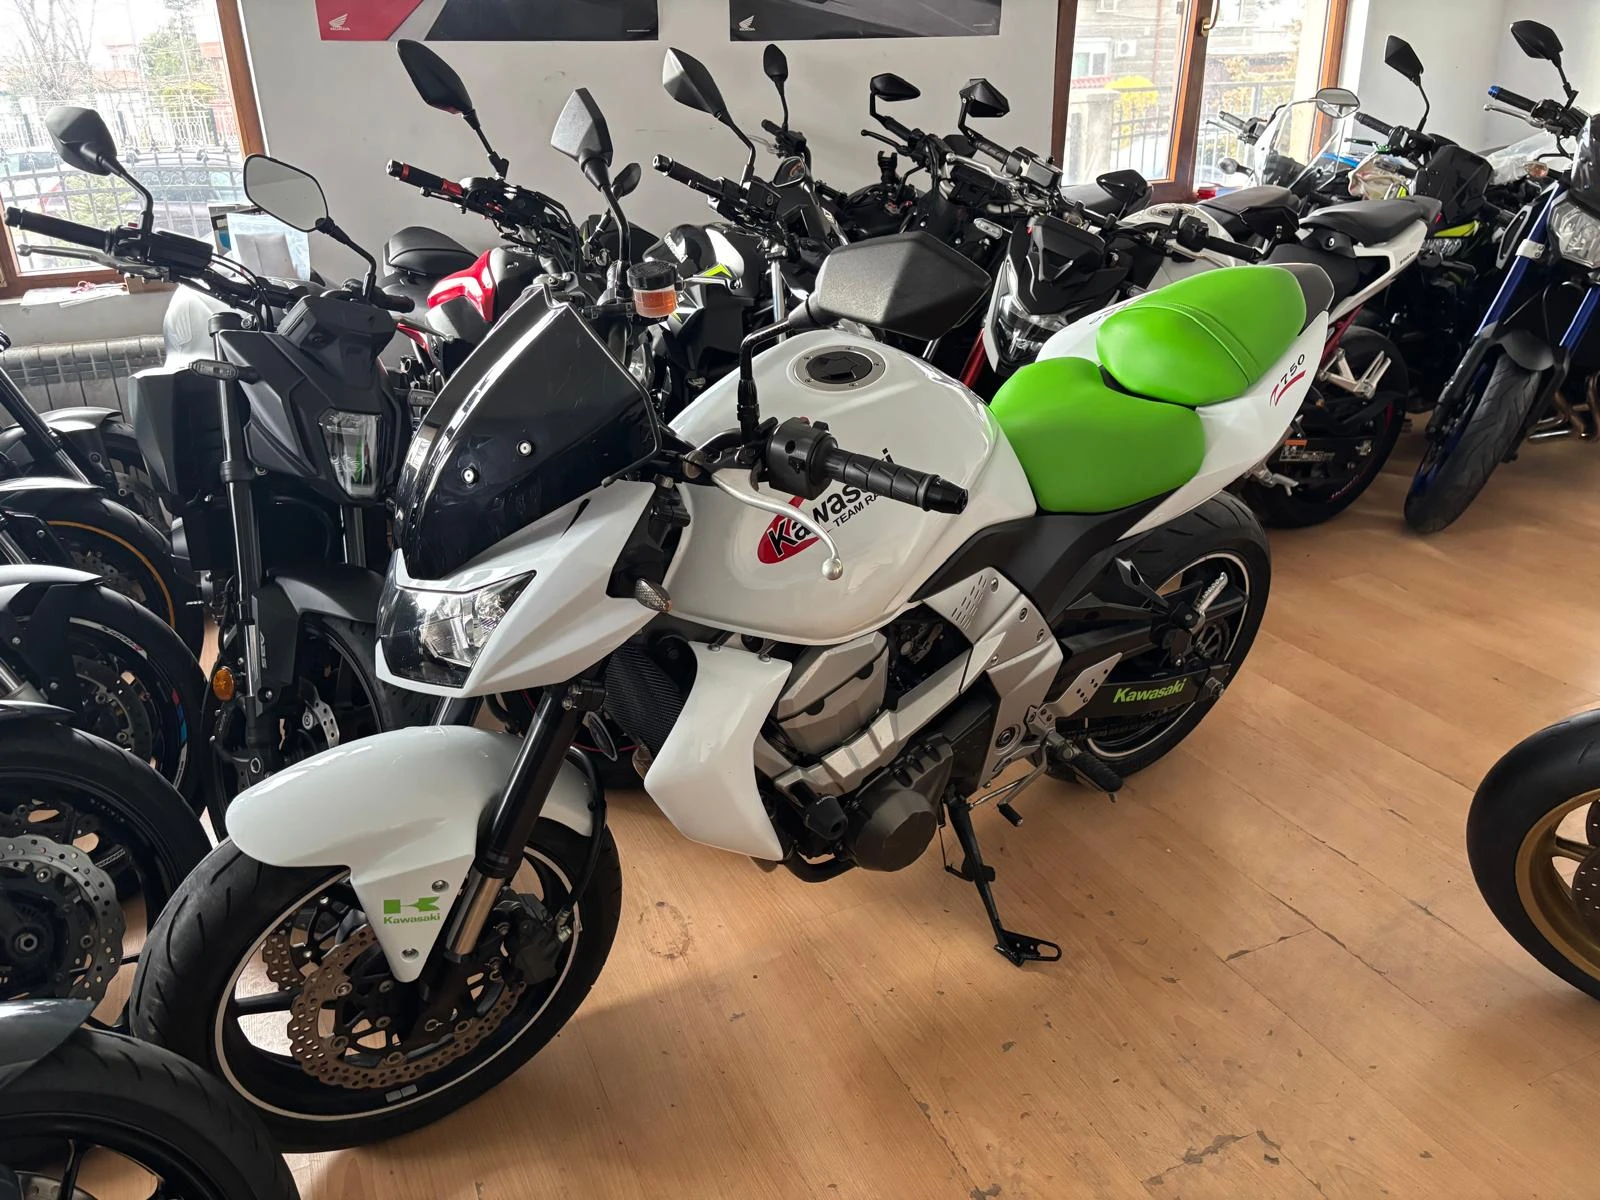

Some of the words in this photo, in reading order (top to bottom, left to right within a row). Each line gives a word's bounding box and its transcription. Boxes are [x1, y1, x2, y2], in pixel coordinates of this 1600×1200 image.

[832, 501, 865, 527] TEAM
[1112, 677, 1187, 703] Kawasaki
[383, 912, 441, 925] Kawasaki
